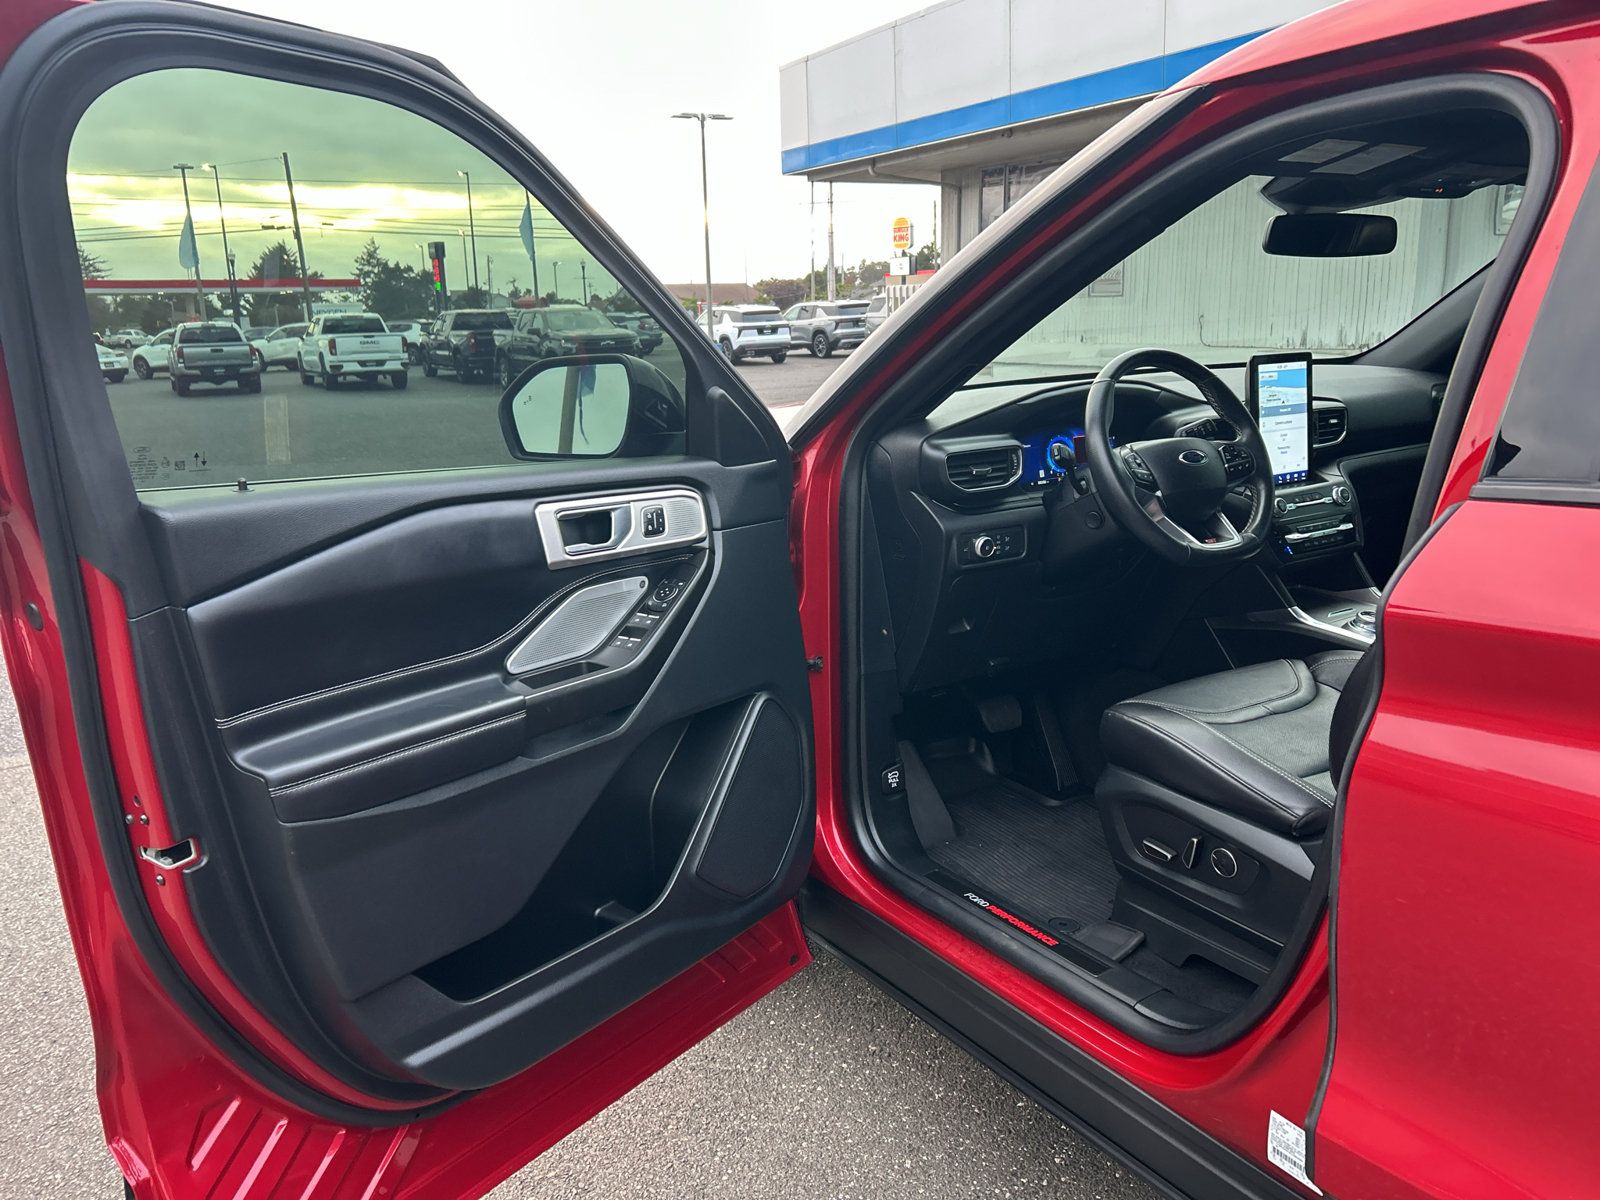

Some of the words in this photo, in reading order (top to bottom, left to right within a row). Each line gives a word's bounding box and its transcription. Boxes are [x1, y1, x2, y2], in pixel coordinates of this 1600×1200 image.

[893, 233, 910, 242] KING
[963, 892, 989, 907] FORD
[986, 905, 1059, 946] PERFORMANCE
